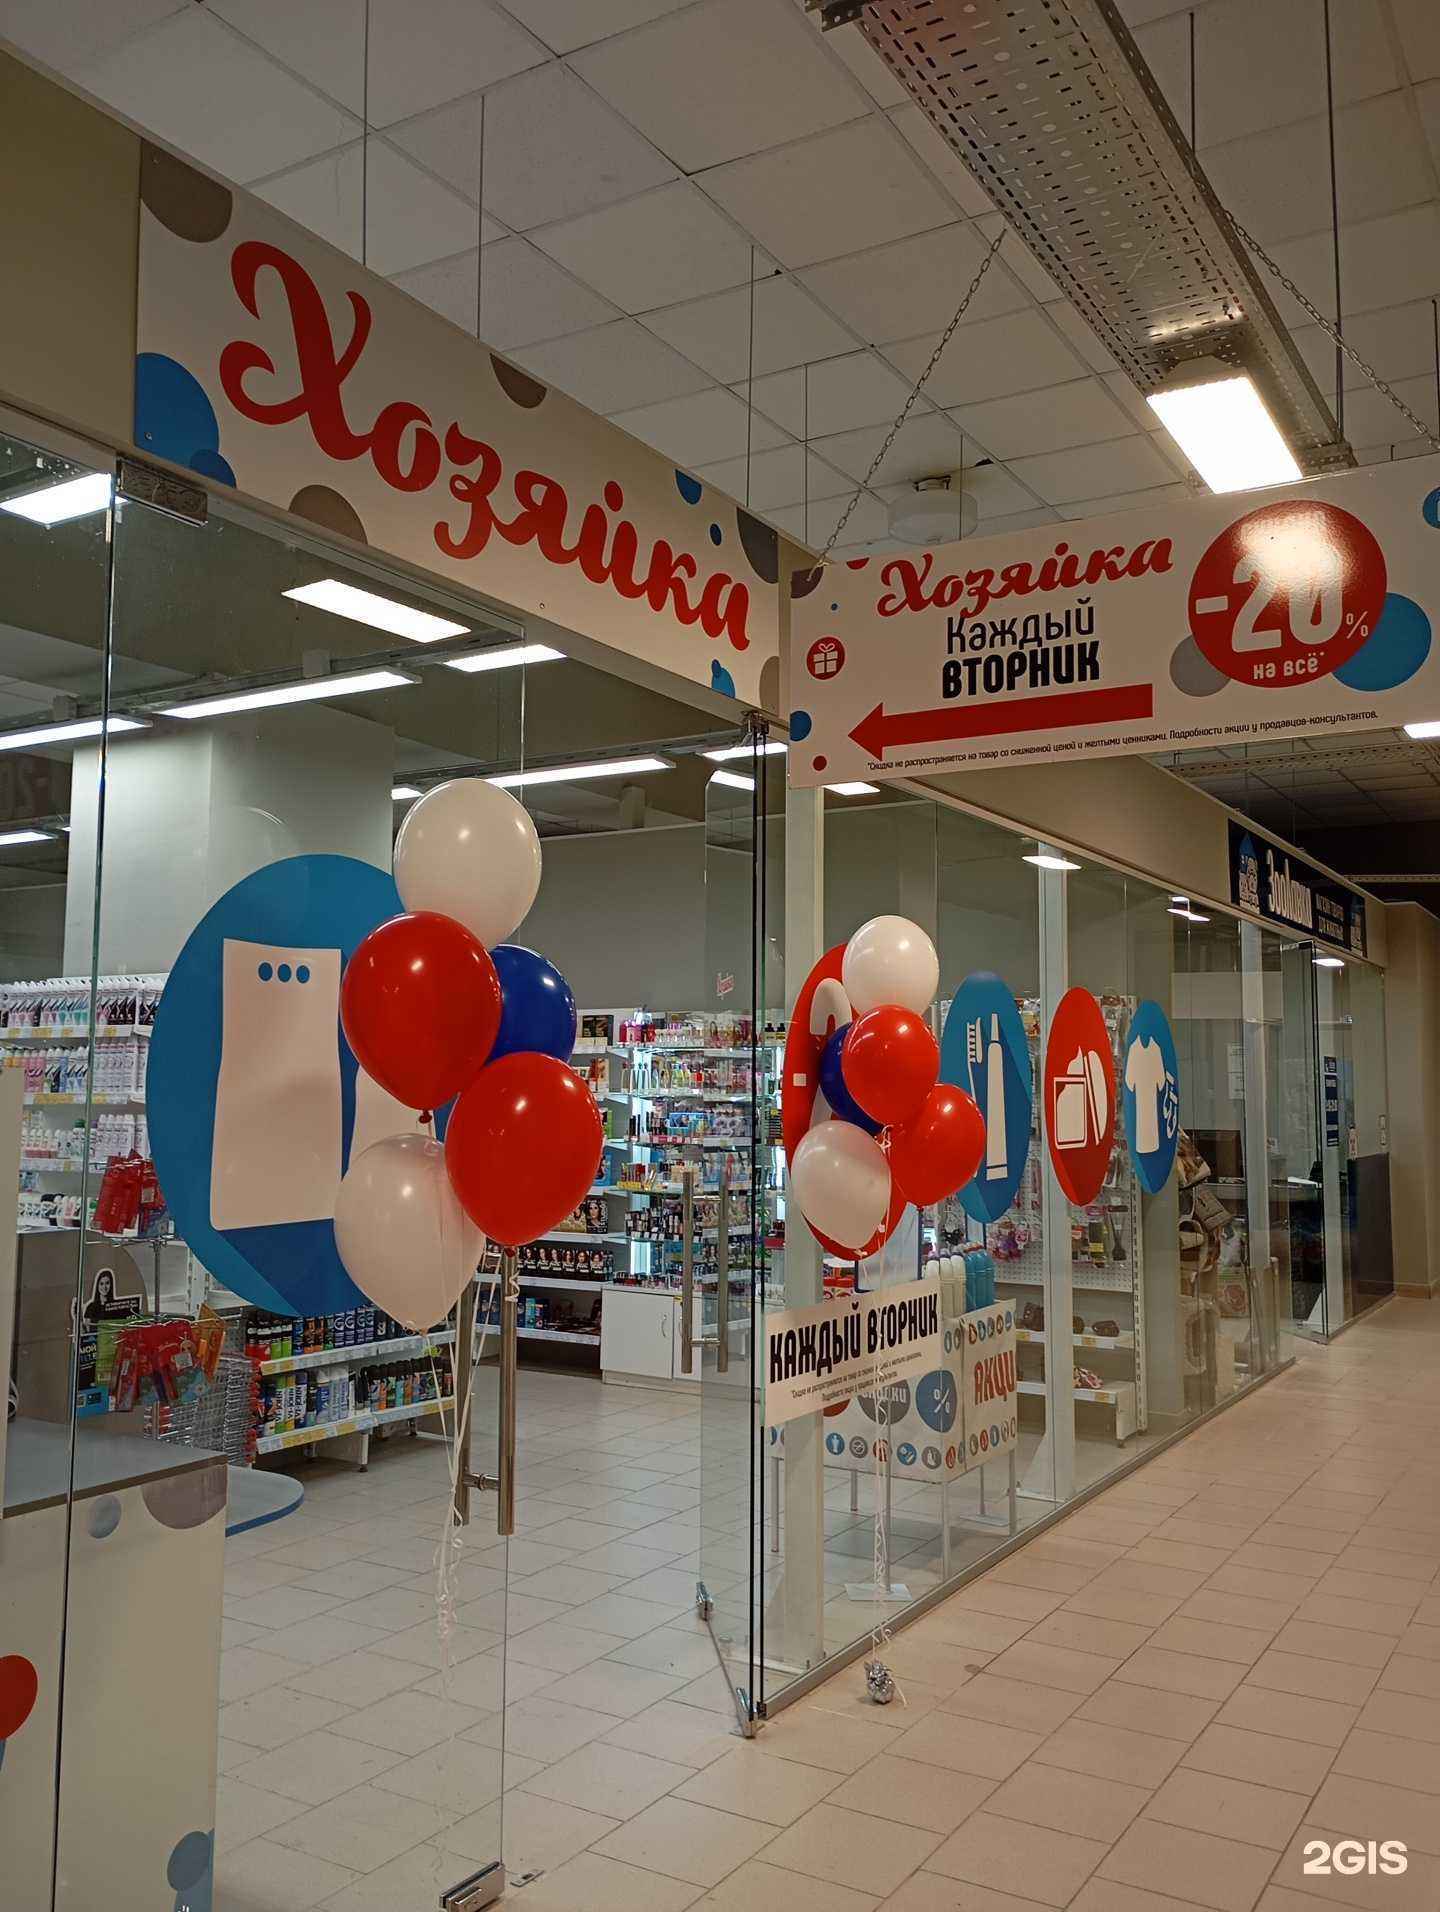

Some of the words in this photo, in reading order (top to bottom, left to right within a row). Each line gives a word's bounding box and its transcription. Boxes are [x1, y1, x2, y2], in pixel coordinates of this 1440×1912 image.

[218, 240, 752, 652] Хозяйка
[877, 537, 1174, 618] Хозяйка
[946, 596, 1095, 655] Каждый
[942, 640, 1100, 699] ВТОРНИК
[1253, 661, 1276, 680] на
[1052, 741, 1076, 753] ценой
[1169, 726, 1222, 740] Подробности
[1224, 724, 1250, 735] акции
[770, 1301, 861, 1384] КАЖДЫЙ
[867, 1293, 938, 1353] ВТОРНИК
